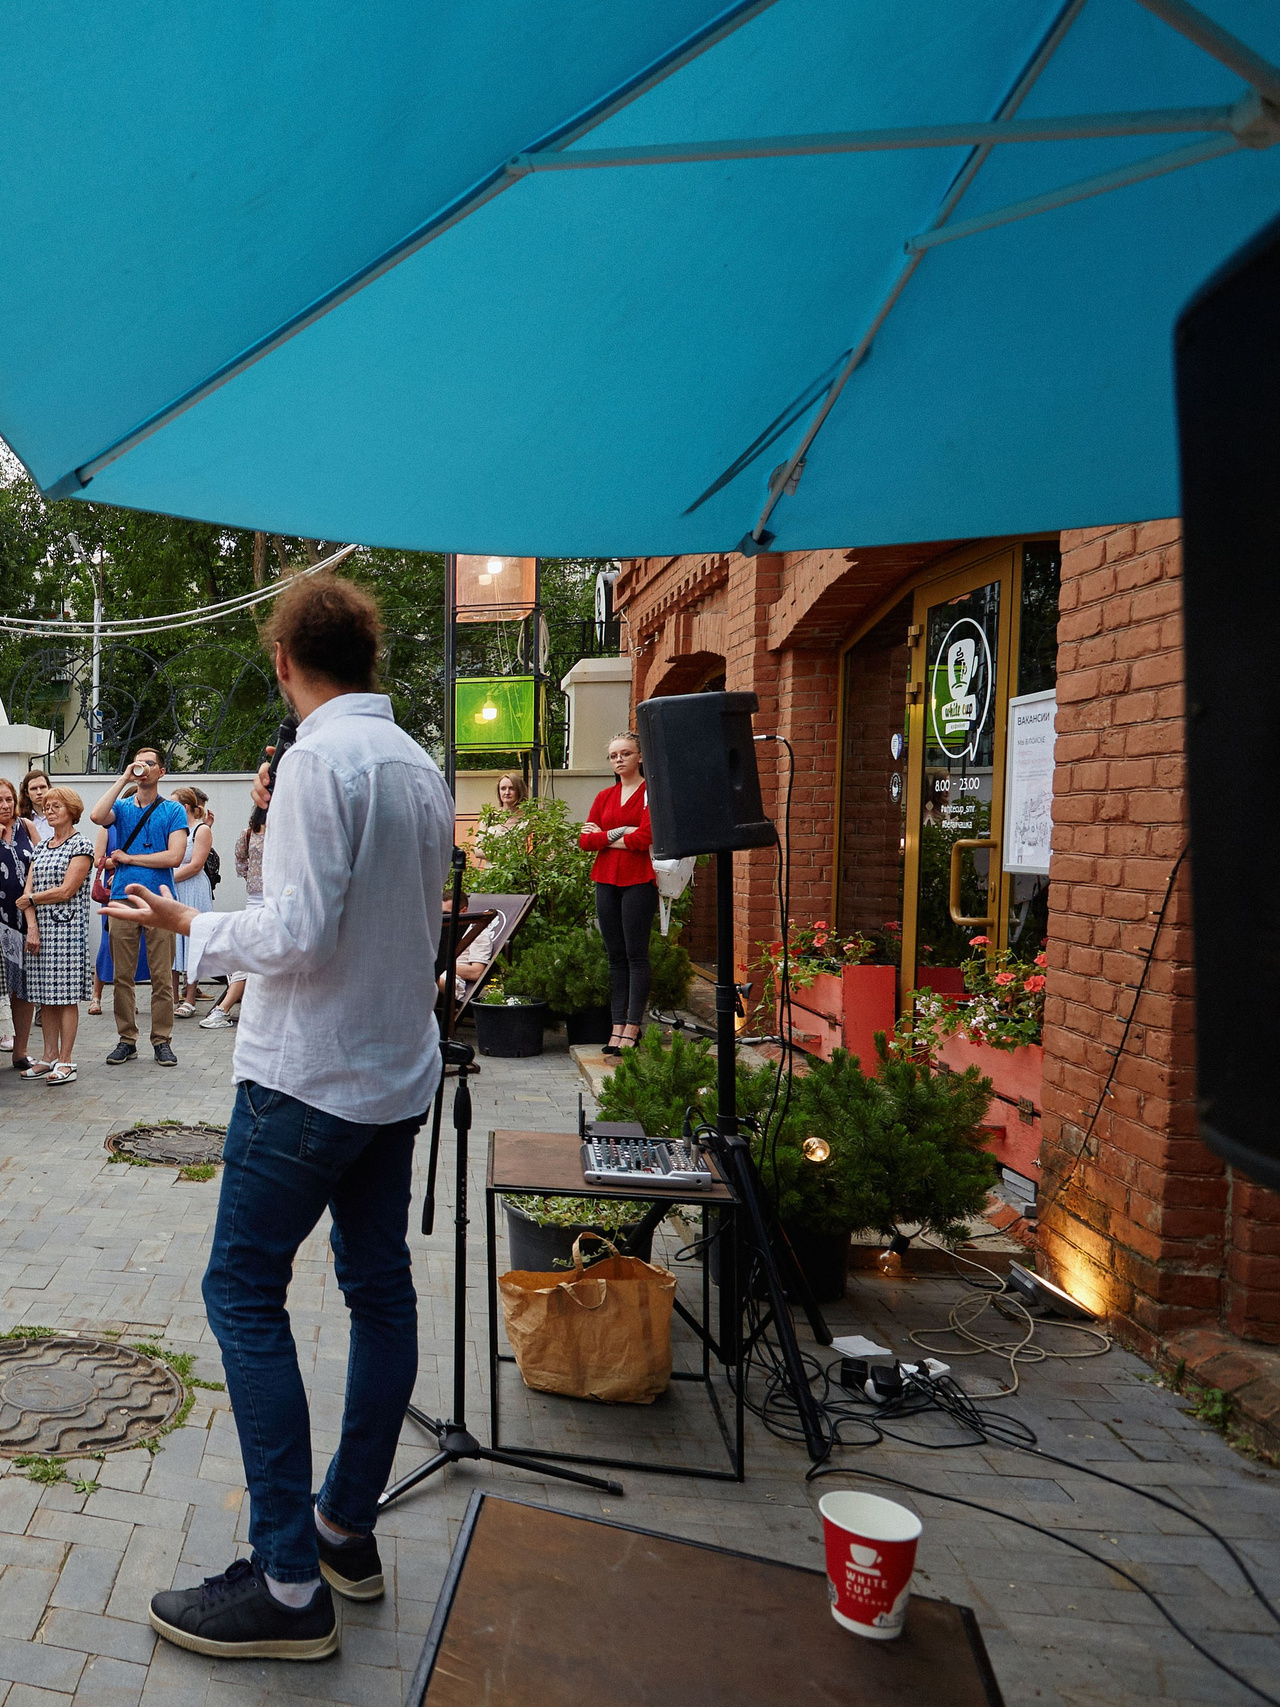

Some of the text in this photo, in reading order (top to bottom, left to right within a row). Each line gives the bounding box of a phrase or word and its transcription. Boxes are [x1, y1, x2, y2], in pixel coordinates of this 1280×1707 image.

[944, 701, 974, 718] white cup
[1017, 712, 1050, 726] ВАКАНСИИ
[934, 779, 951, 792] 8.00
[959, 776, 980, 791] 23.00
[845, 1569, 888, 1590] WHITE
[845, 1580, 871, 1596] CUP
